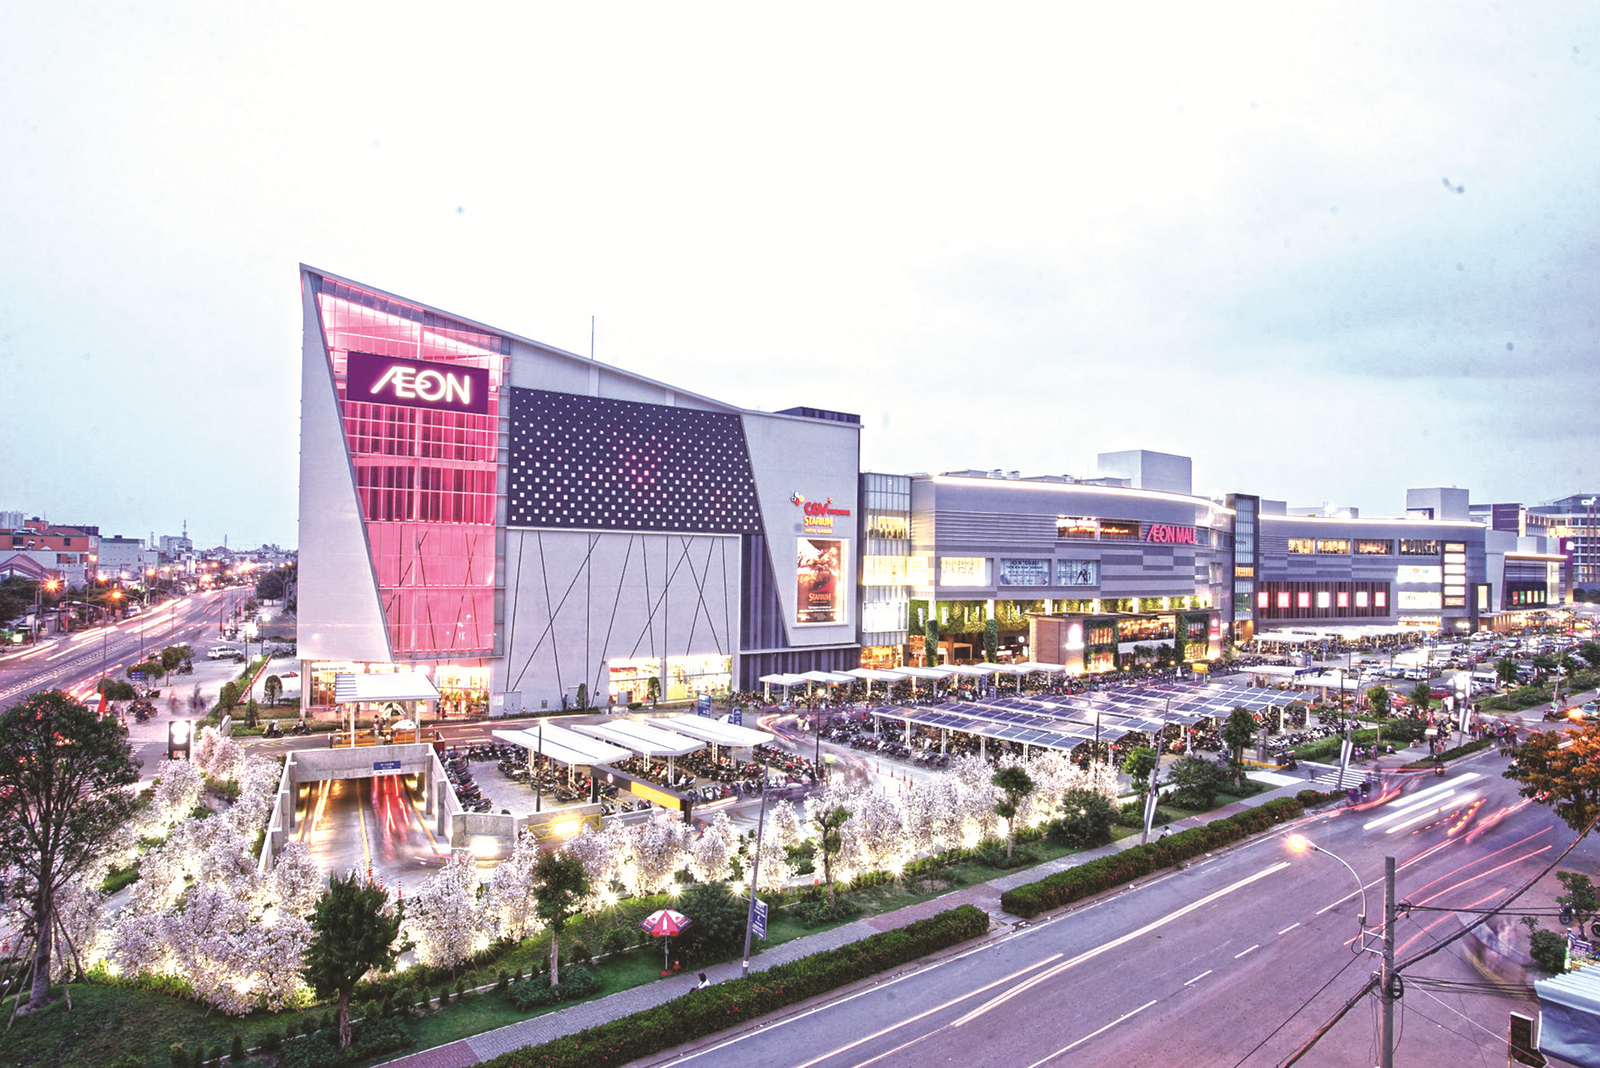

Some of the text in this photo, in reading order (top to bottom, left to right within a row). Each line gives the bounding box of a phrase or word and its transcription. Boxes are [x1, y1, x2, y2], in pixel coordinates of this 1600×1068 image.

[804, 502, 829, 516] CGV
[804, 516, 833, 528] STARIUM
[1176, 526, 1198, 545] MALL
